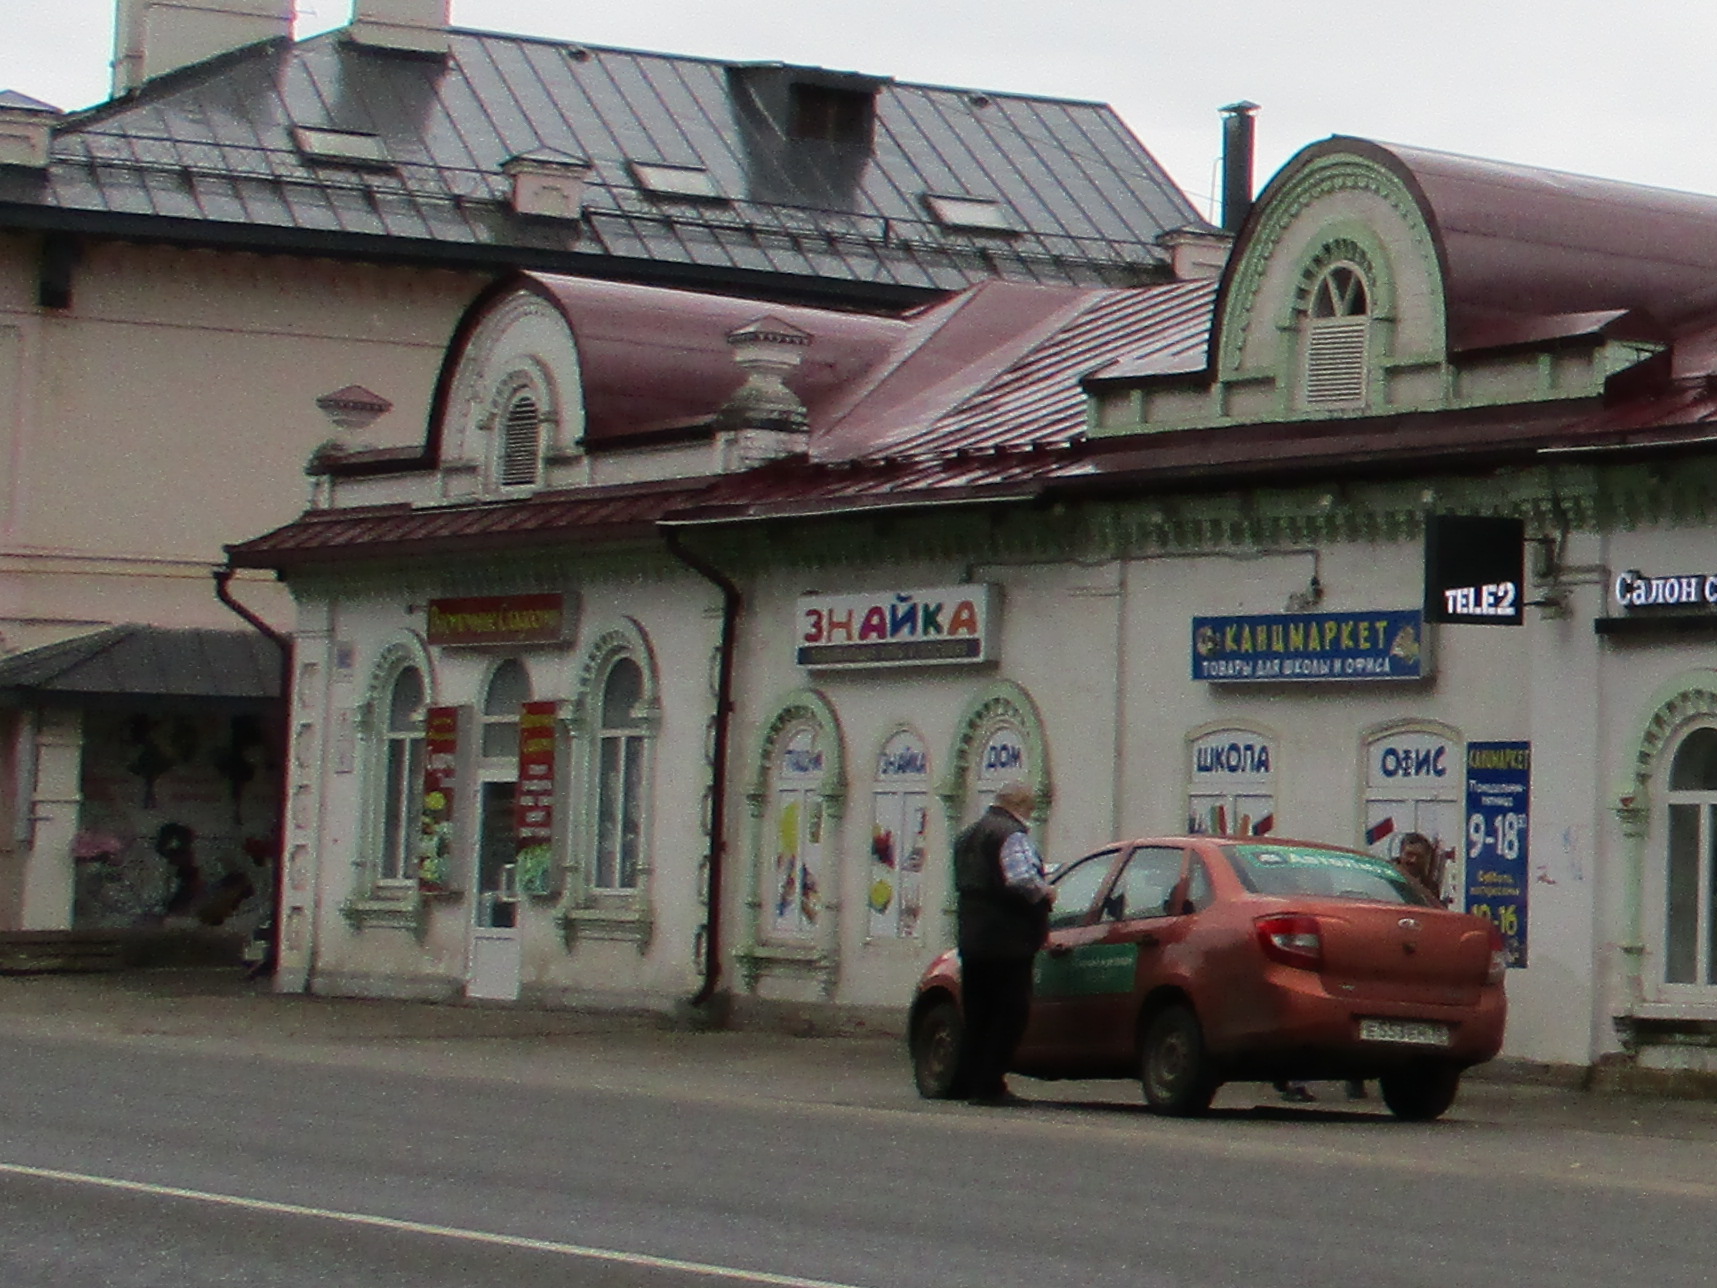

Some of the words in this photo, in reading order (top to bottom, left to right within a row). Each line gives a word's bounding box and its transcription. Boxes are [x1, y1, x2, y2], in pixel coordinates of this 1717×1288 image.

[1445, 581, 1517, 616] TELE2
[1615, 571, 1699, 606] Салон
[804, 593, 979, 643] ЗНАЙКА
[1224, 620, 1389, 653] КАНЦМАРКЕТ
[1202, 660, 1252, 676] ТОВАРЫ
[1254, 659, 1280, 676] ДЛЯ
[1281, 658, 1331, 675] ШКОЛЫ
[1344, 657, 1391, 674] ОФИСА
[1196, 742, 1270, 775] ШКОЛА
[1381, 745, 1447, 777] ОФИС
